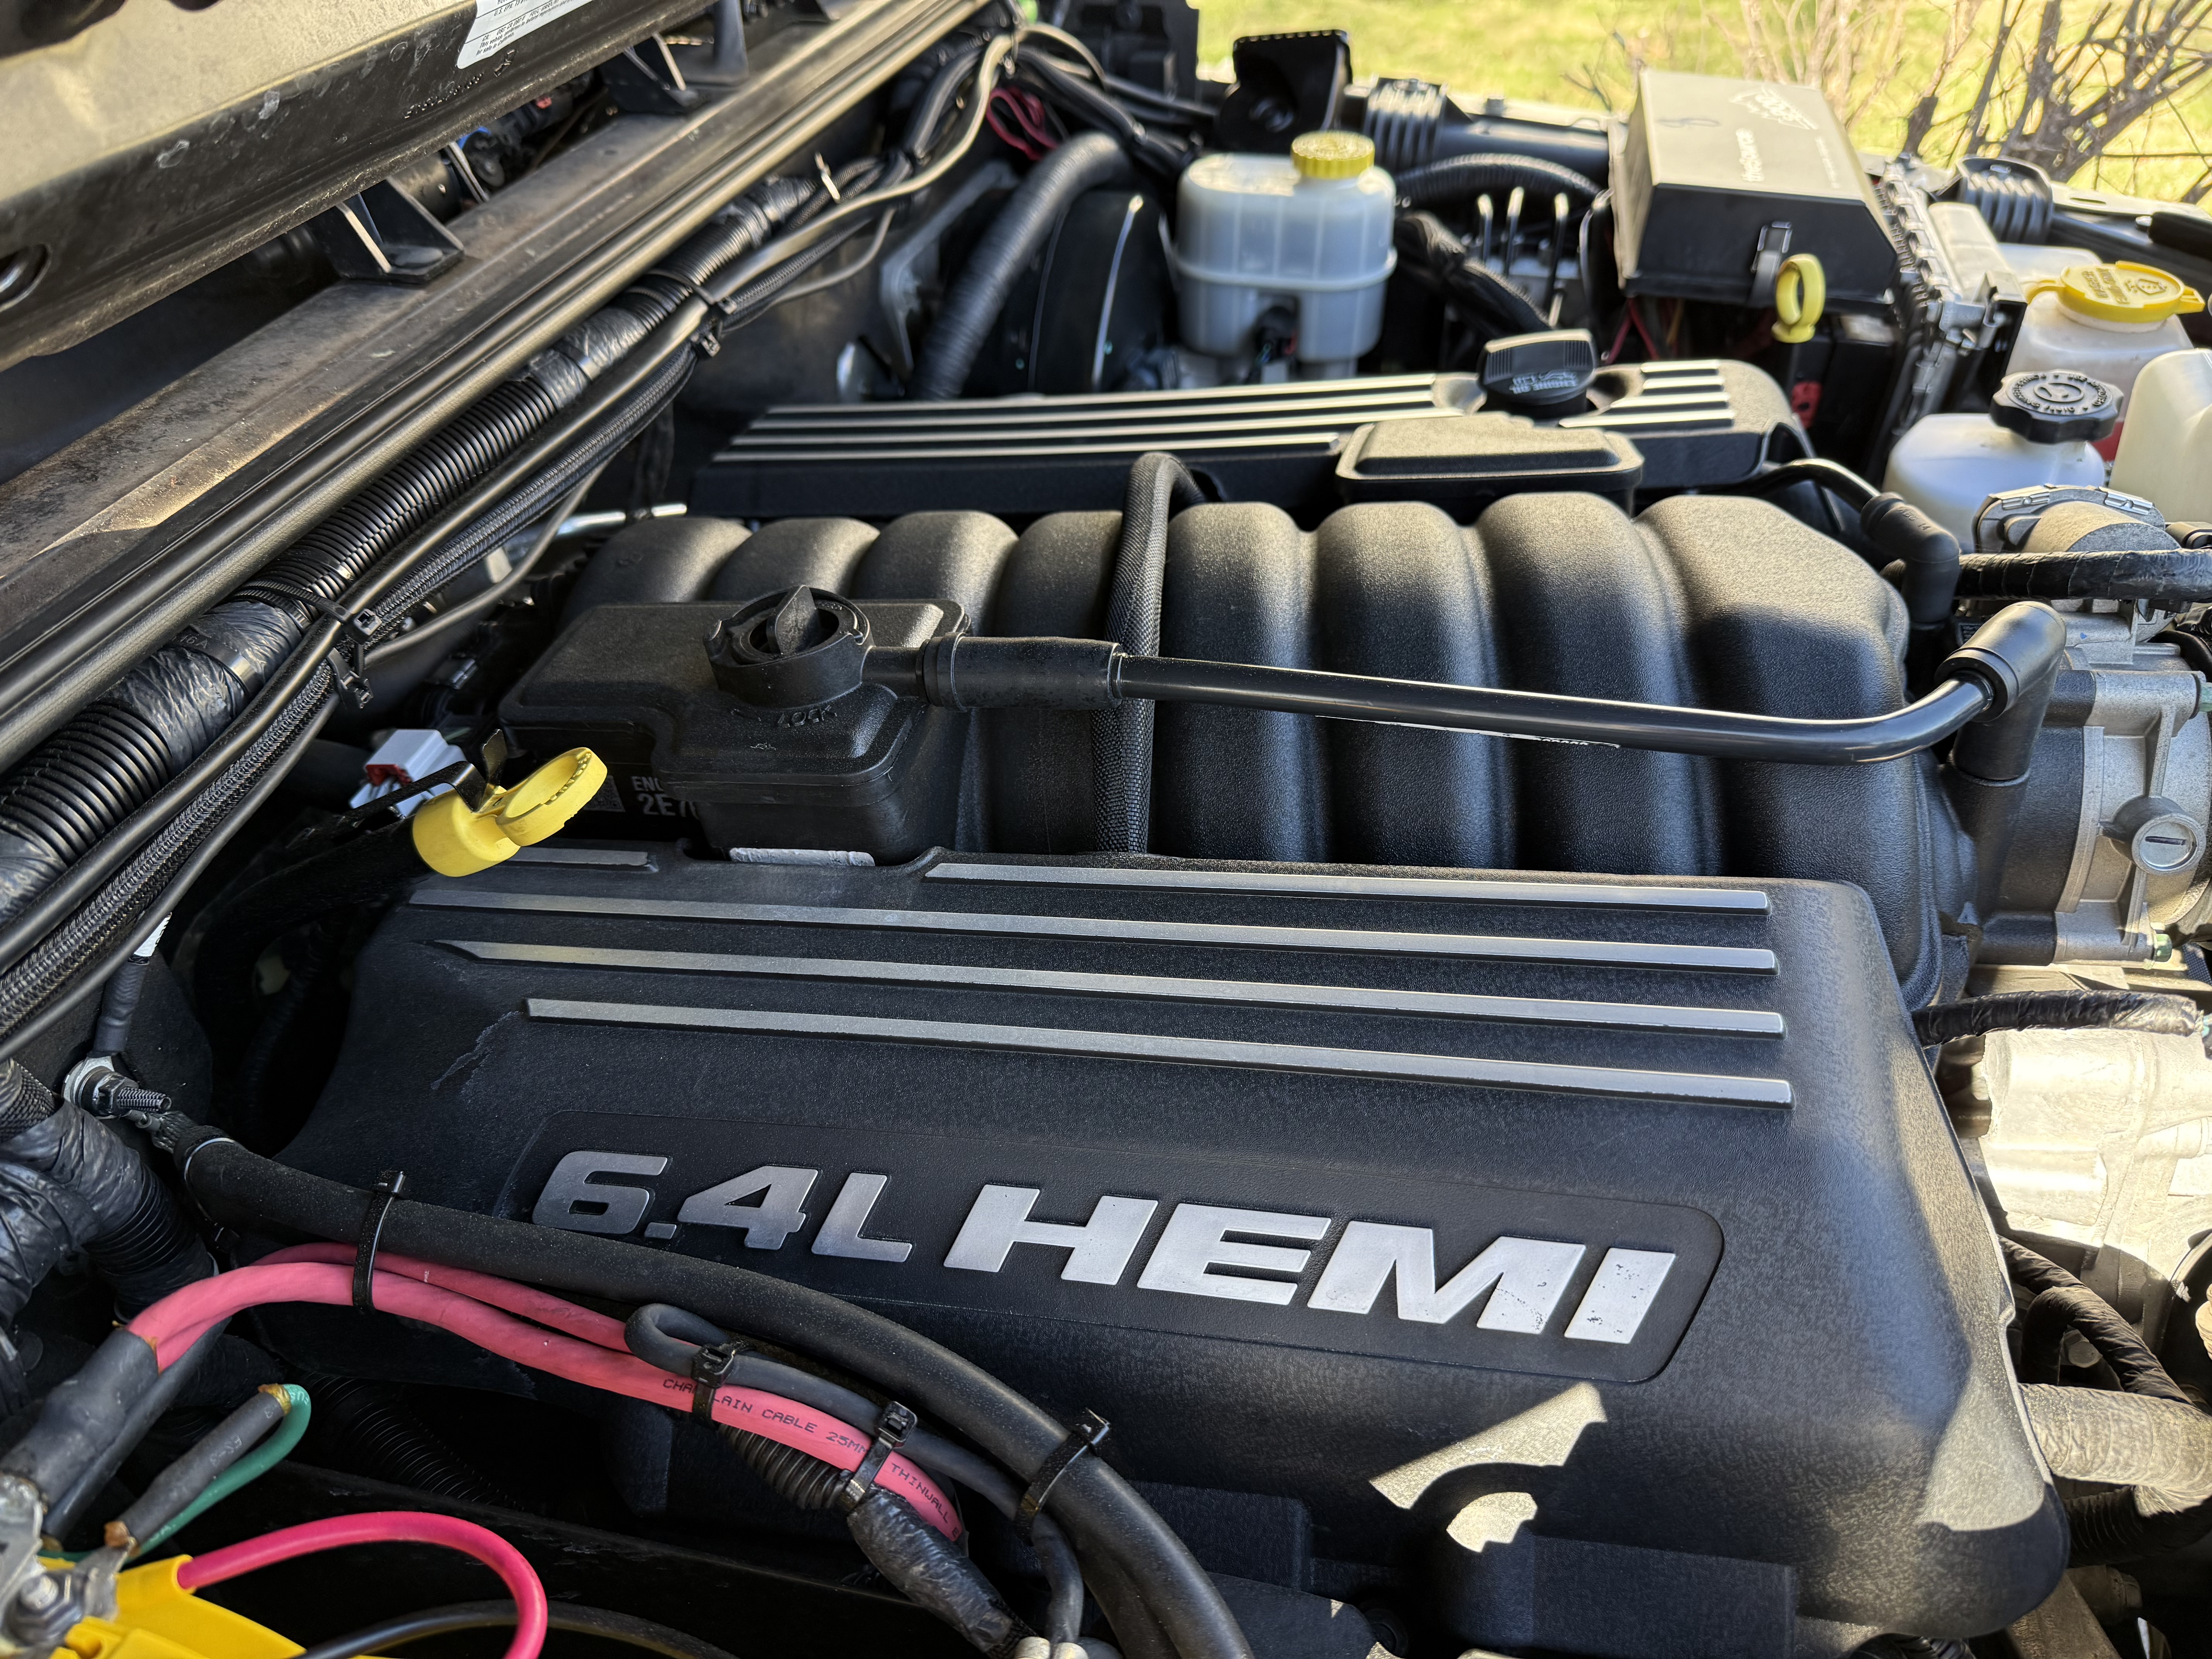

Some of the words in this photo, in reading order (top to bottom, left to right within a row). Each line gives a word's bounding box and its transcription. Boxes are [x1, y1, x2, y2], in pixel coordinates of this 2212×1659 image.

[532, 1150, 913, 1263] 6.4L
[943, 1183, 1677, 1344] HEMI
[663, 1379, 753, 1413] CHAAIN
[762, 1408, 818, 1434] CABLE
[891, 1463, 948, 1523] THINWALL
